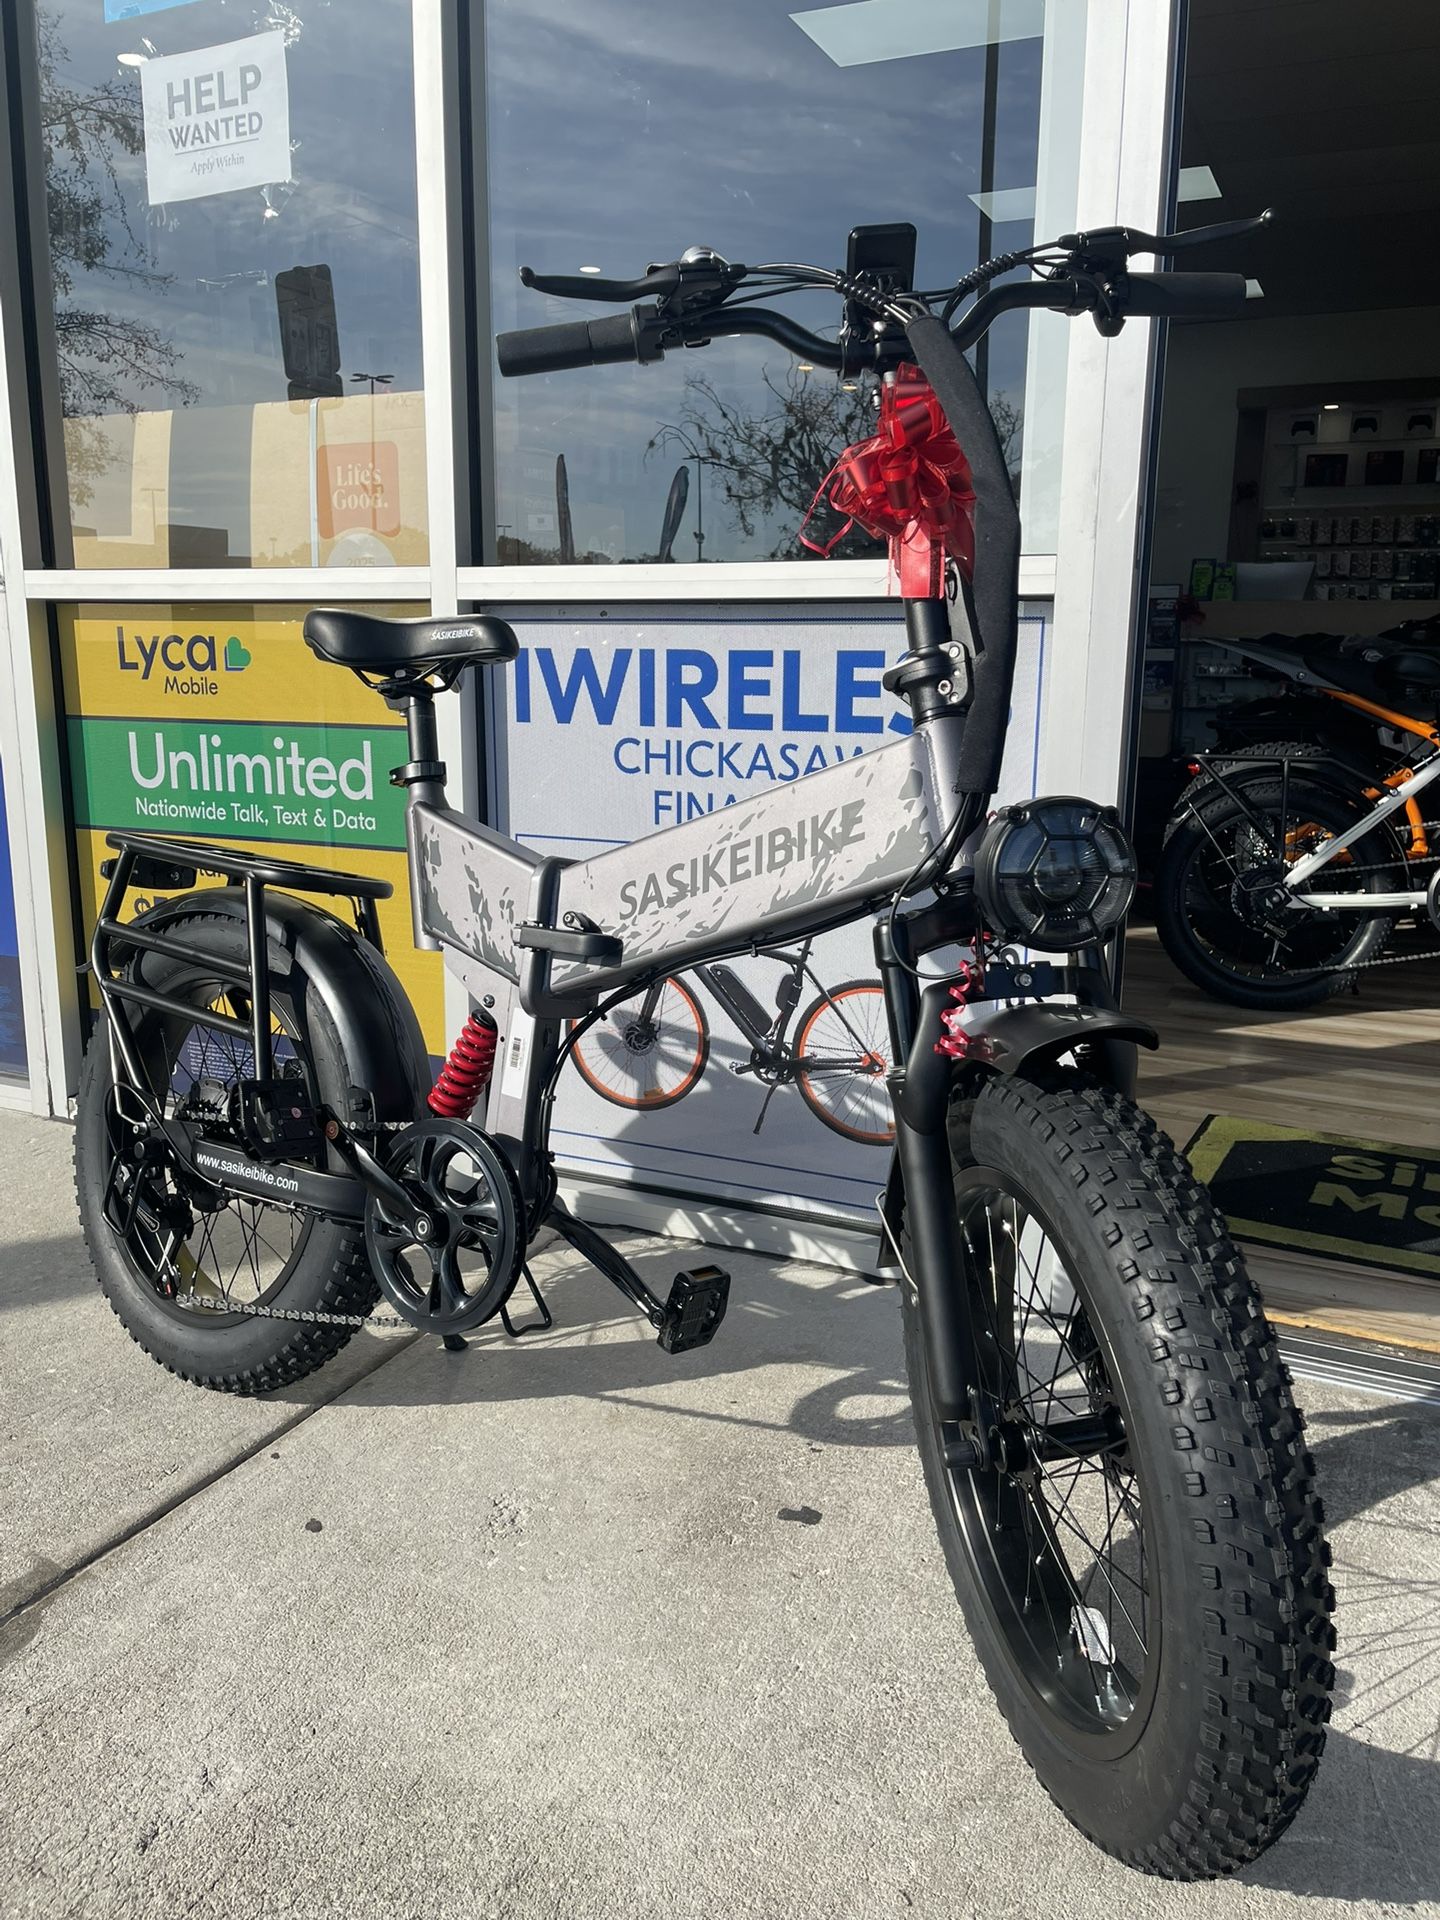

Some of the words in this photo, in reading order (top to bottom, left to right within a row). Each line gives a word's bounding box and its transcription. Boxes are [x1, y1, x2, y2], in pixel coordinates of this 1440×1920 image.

[167, 64, 262, 120] HELP
[168, 112, 263, 149] WANTED
[190, 158, 215, 176] Apply
[216, 153, 245, 169] Within
[336, 463, 382, 487] Life's
[333, 488, 389, 511] Good.
[430, 627, 475, 641] SASIKEIBIKE
[117, 626, 217, 680] Lyca
[164, 676, 218, 695] Mobile
[128, 731, 374, 801] Unlimited
[613, 738, 864, 782] CHICKASA
[135, 797, 227, 821] Nationwide
[230, 803, 269, 827] Talk,
[273, 805, 308, 827] Text
[313, 808, 327, 828] &
[333, 808, 376, 831] Data
[619, 799, 866, 921] SASIKEIBIKE
[196, 1153, 299, 1192] www.sasikeibike.com
